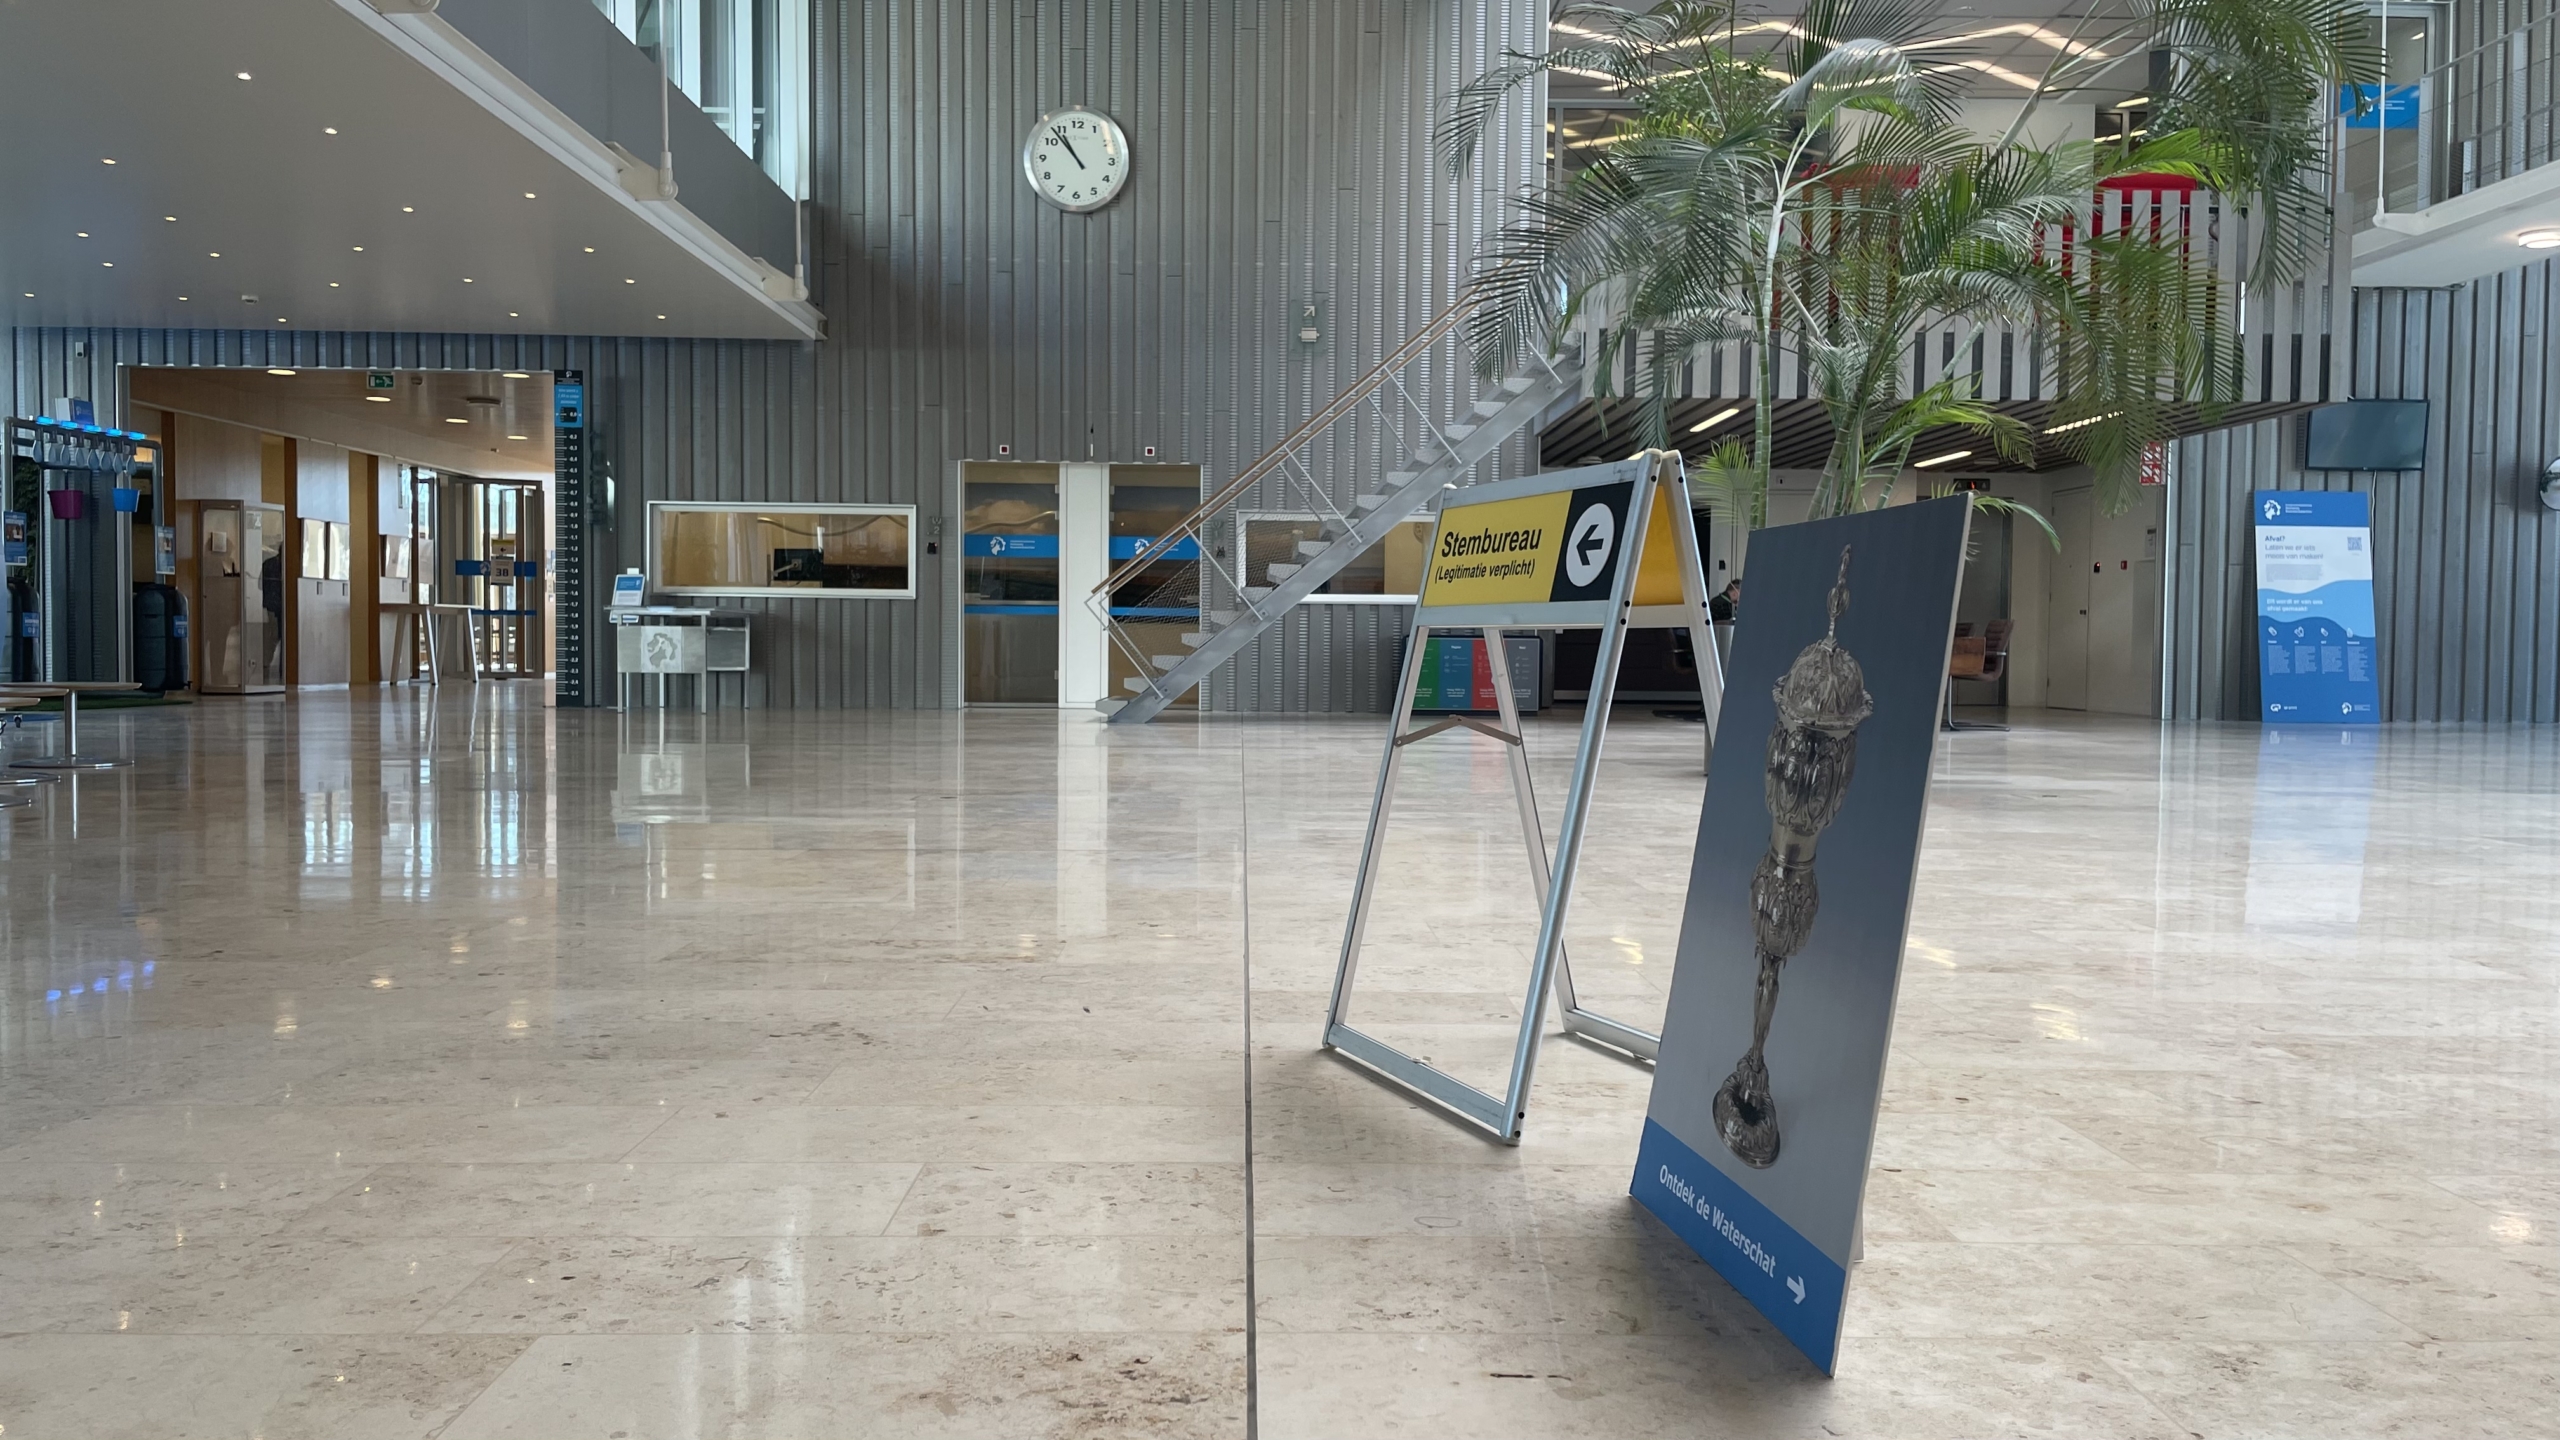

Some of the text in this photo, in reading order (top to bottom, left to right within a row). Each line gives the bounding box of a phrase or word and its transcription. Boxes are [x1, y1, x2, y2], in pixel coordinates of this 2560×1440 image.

[1072, 120, 1084, 129] 12
[1057, 126, 1067, 134] 11
[1092, 125, 1097, 133] 1
[1045, 138, 1058, 146] 10
[1039, 154, 1047, 162] 9
[1108, 157, 1115, 166] 3
[1044, 172, 1051, 180] 8
[1102, 175, 1110, 183] 4
[1057, 185, 1065, 193] 7
[1090, 187, 1097, 195] 5
[1072, 191, 1080, 199] 6
[1441, 527, 1542, 558] Stembureau
[1434, 558, 1535, 584] (Legitimatie verplicht)
[1659, 1164, 1777, 1278] Ontdek de Waterschat
